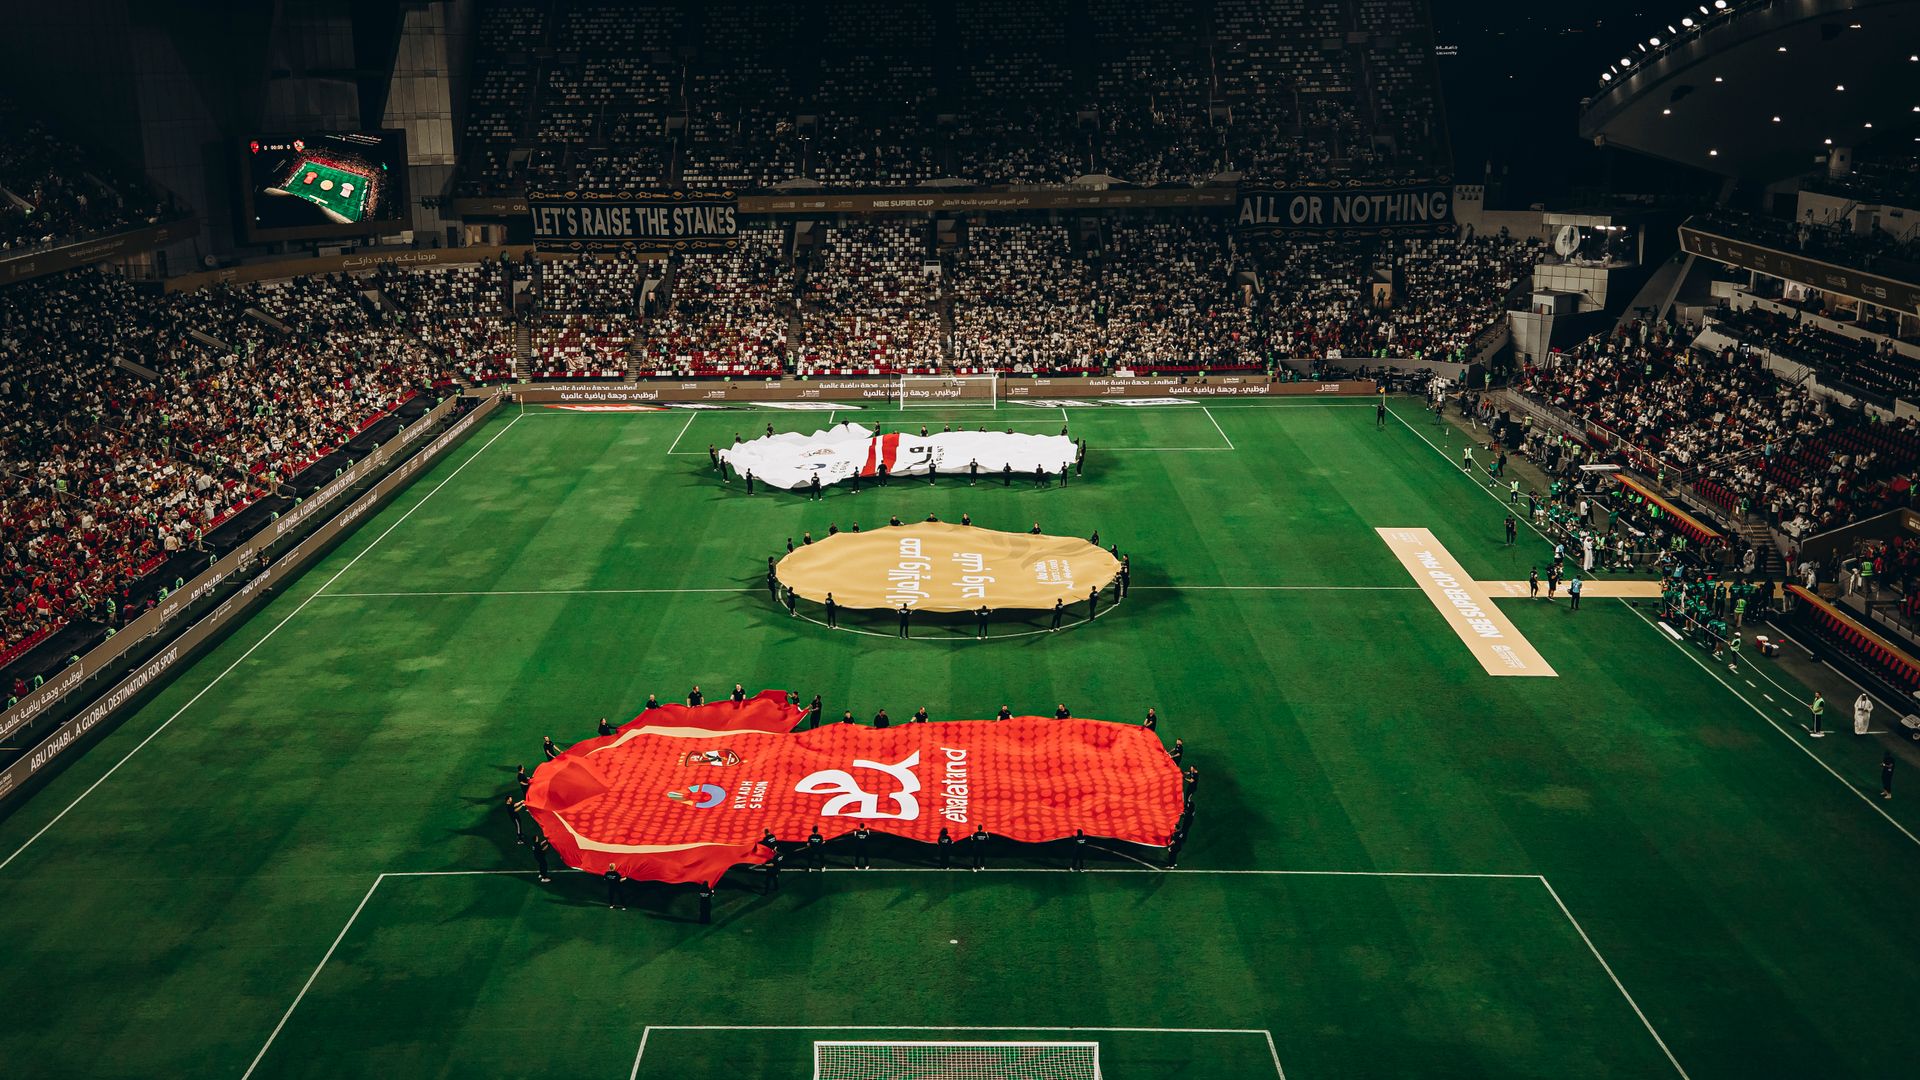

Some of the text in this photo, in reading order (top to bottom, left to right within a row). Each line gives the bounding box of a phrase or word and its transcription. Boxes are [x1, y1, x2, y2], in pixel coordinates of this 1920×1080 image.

[890, 199, 916, 207] SUPER
[1238, 195, 1280, 225] ALL
[1289, 195, 1323, 224] OR
[1332, 191, 1448, 224] NOTHING
[531, 206, 737, 236] LET'S RAISE THE STAKES
[899, 537, 932, 561] مصر
[951, 575, 996, 598] واحد
[1428, 569, 1461, 589] CUP
[1442, 587, 1486, 618] SUPER
[1466, 617, 1504, 638] NBE
[30, 647, 178, 772] ABU DHABI.. A GLOBAL DESTINATION FOR SPORT
[733, 781, 754, 809] RIYADH
[749, 781, 769, 809] SEASON
